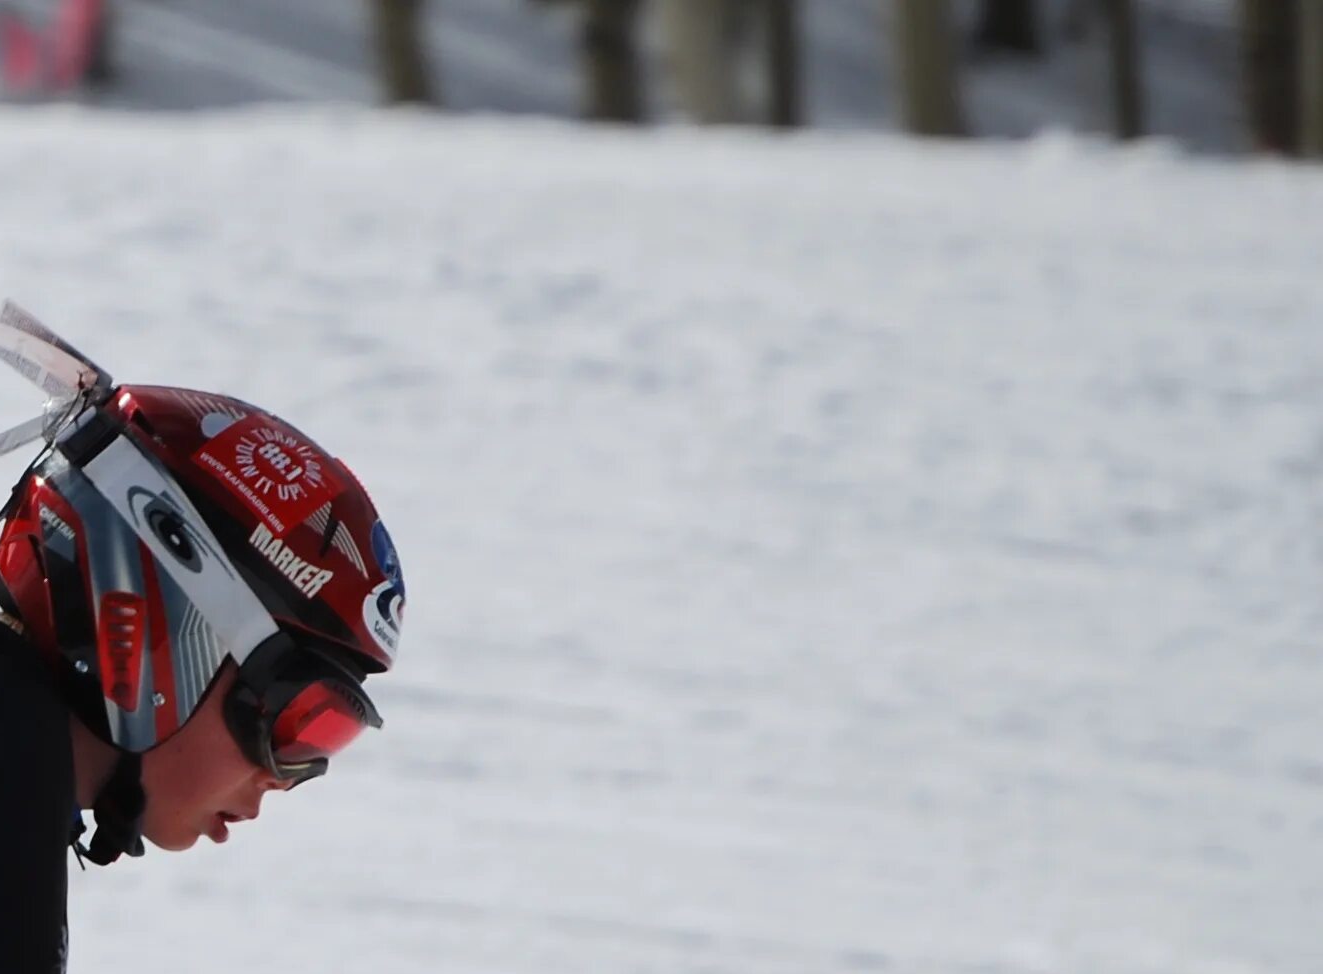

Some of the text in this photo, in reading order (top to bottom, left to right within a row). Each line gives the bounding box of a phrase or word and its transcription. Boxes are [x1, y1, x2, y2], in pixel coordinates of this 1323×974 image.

[250, 427, 297, 448] TURN
[258, 442, 303, 482] 88.1
[235, 436, 260, 478] TURN
[254, 476, 276, 494] IT
[249, 521, 334, 600] MARKER
